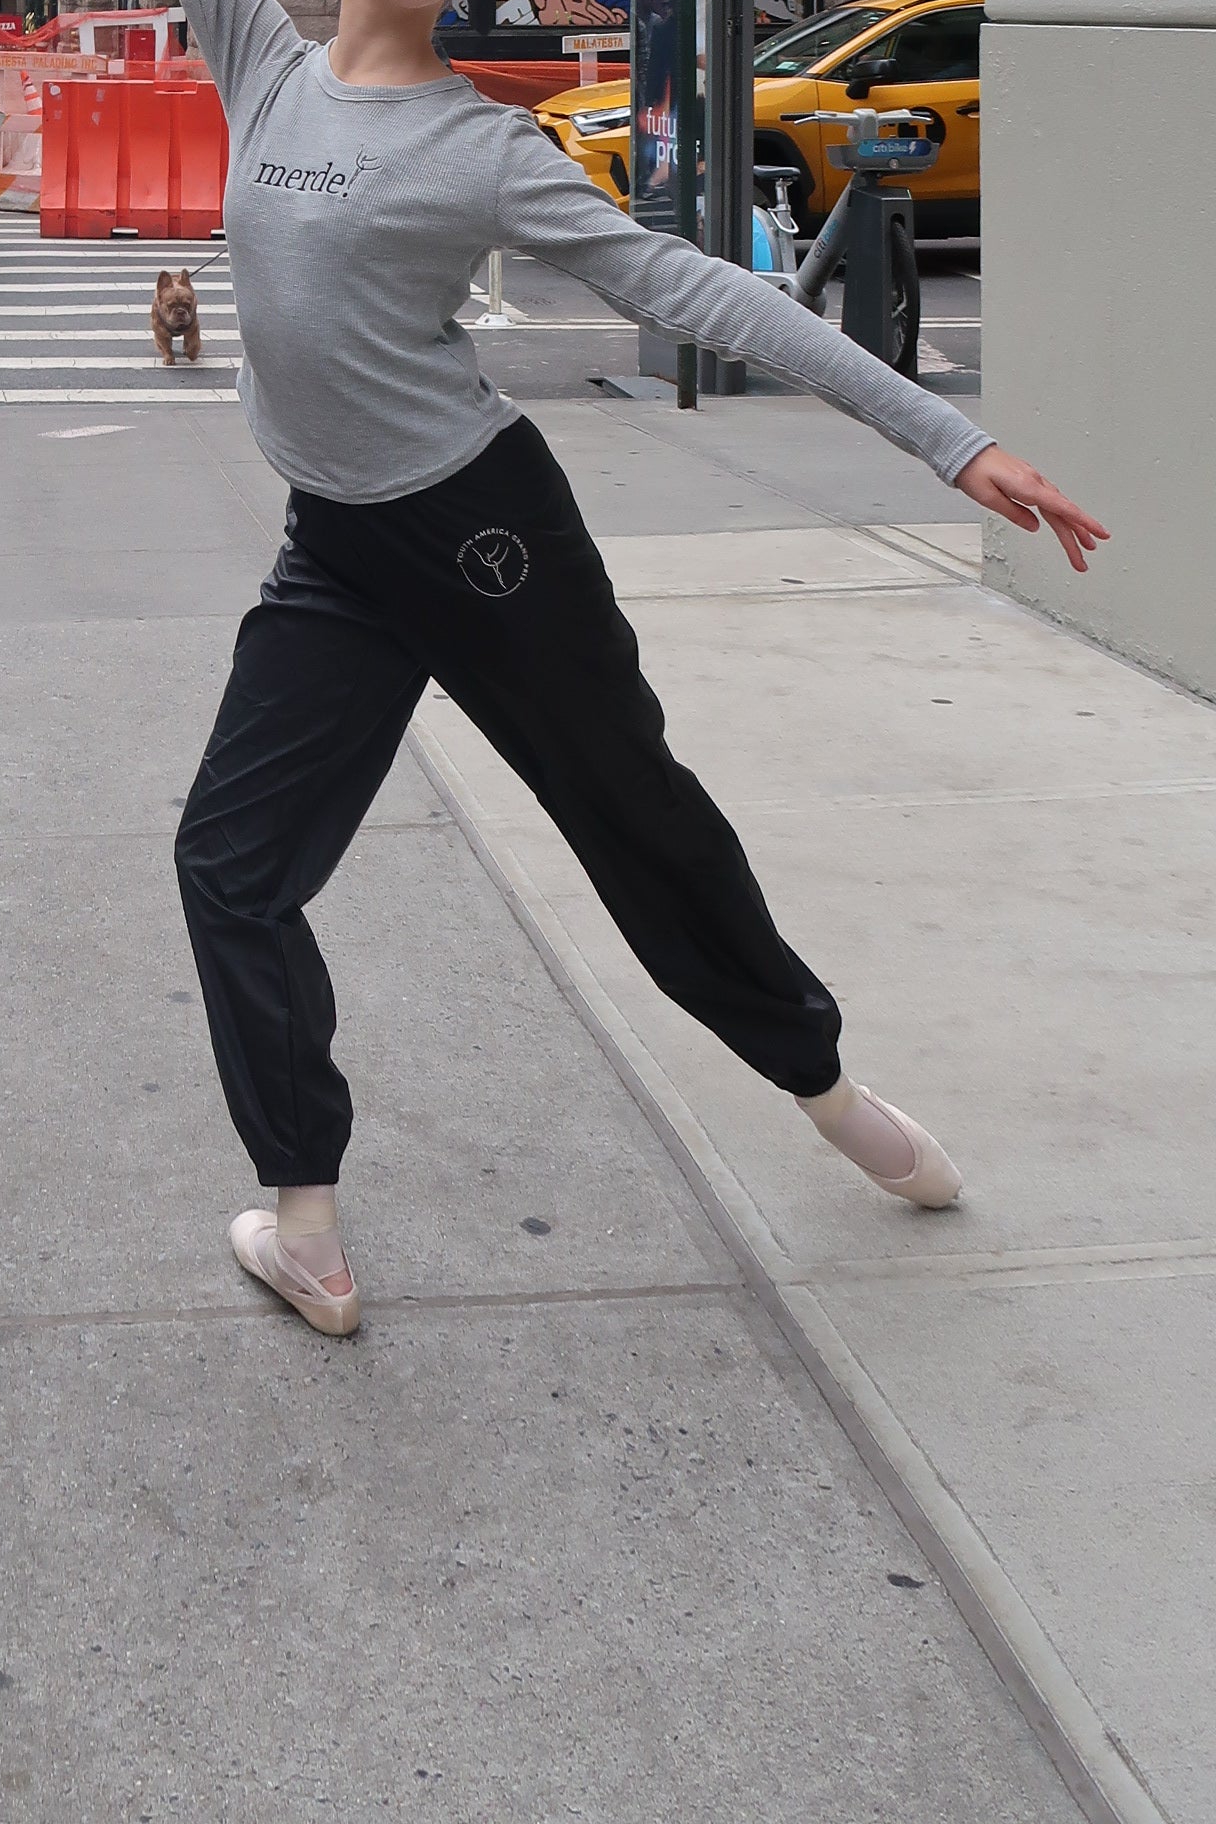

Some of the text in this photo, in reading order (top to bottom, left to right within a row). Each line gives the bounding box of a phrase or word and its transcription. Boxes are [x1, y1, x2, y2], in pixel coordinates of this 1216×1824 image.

[573, 37, 624, 50] MALATESTA
[456, 527, 529, 582] YOUTH AMERICA GRAND PRIX
